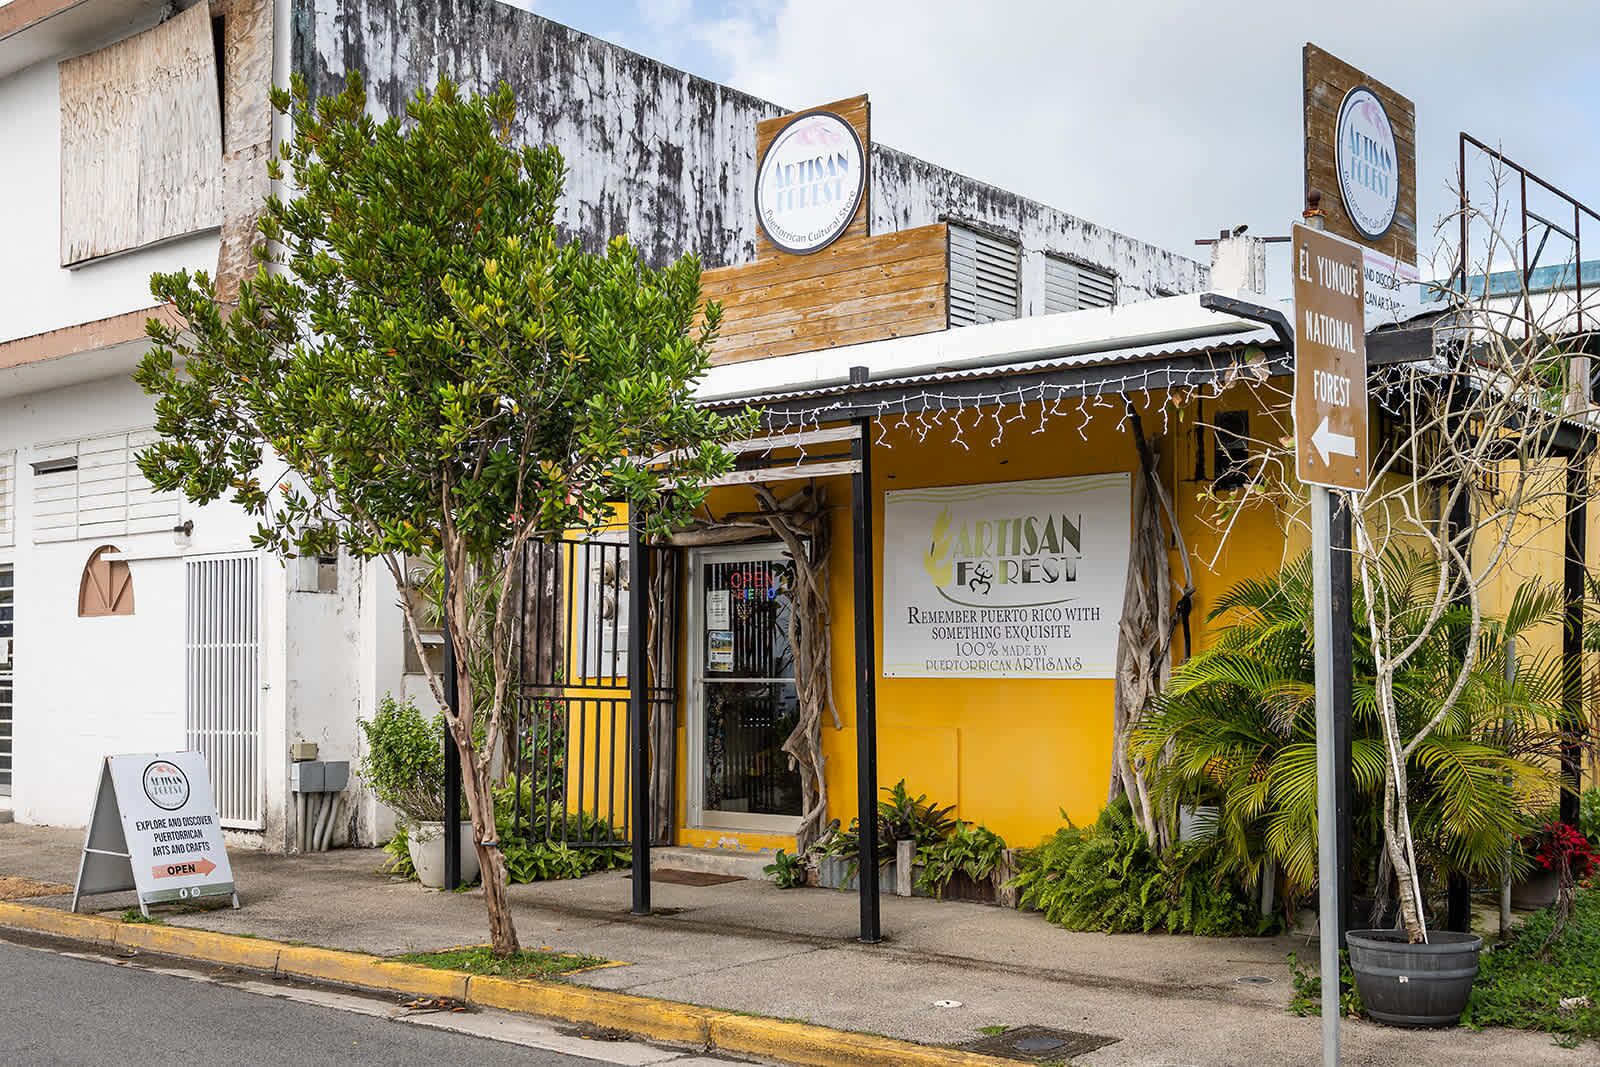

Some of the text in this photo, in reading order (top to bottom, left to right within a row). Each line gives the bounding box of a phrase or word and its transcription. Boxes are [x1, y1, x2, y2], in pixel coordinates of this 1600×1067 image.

[775, 149, 848, 188] ARTISAN
[766, 189, 856, 243] Puertorrican Cultural Store
[1299, 248, 1359, 298] EL YUNQUE
[1305, 309, 1356, 353] NATIONAL
[1313, 369, 1351, 407] FOREST
[953, 512, 1082, 558] ARTISAN
[731, 571, 775, 588] OPEN
[957, 556, 1082, 587] FOREST
[980, 607, 1028, 623] PUERTO
[1031, 607, 1062, 623] RICO
[1064, 607, 1101, 622] WITH
[931, 625, 1072, 641] SOMETHING EXQUISITE
[955, 641, 1048, 657] 100% MADE BY
[925, 657, 1082, 672] PUERTORRICAN ARTISANS
[135, 815, 213, 832] EXPLORE AND DISCOVER
[153, 829, 203, 843] PUERTORRICAN
[152, 841, 211, 857] ARTS AND CRAFTS
[167, 863, 196, 875] OPEN
